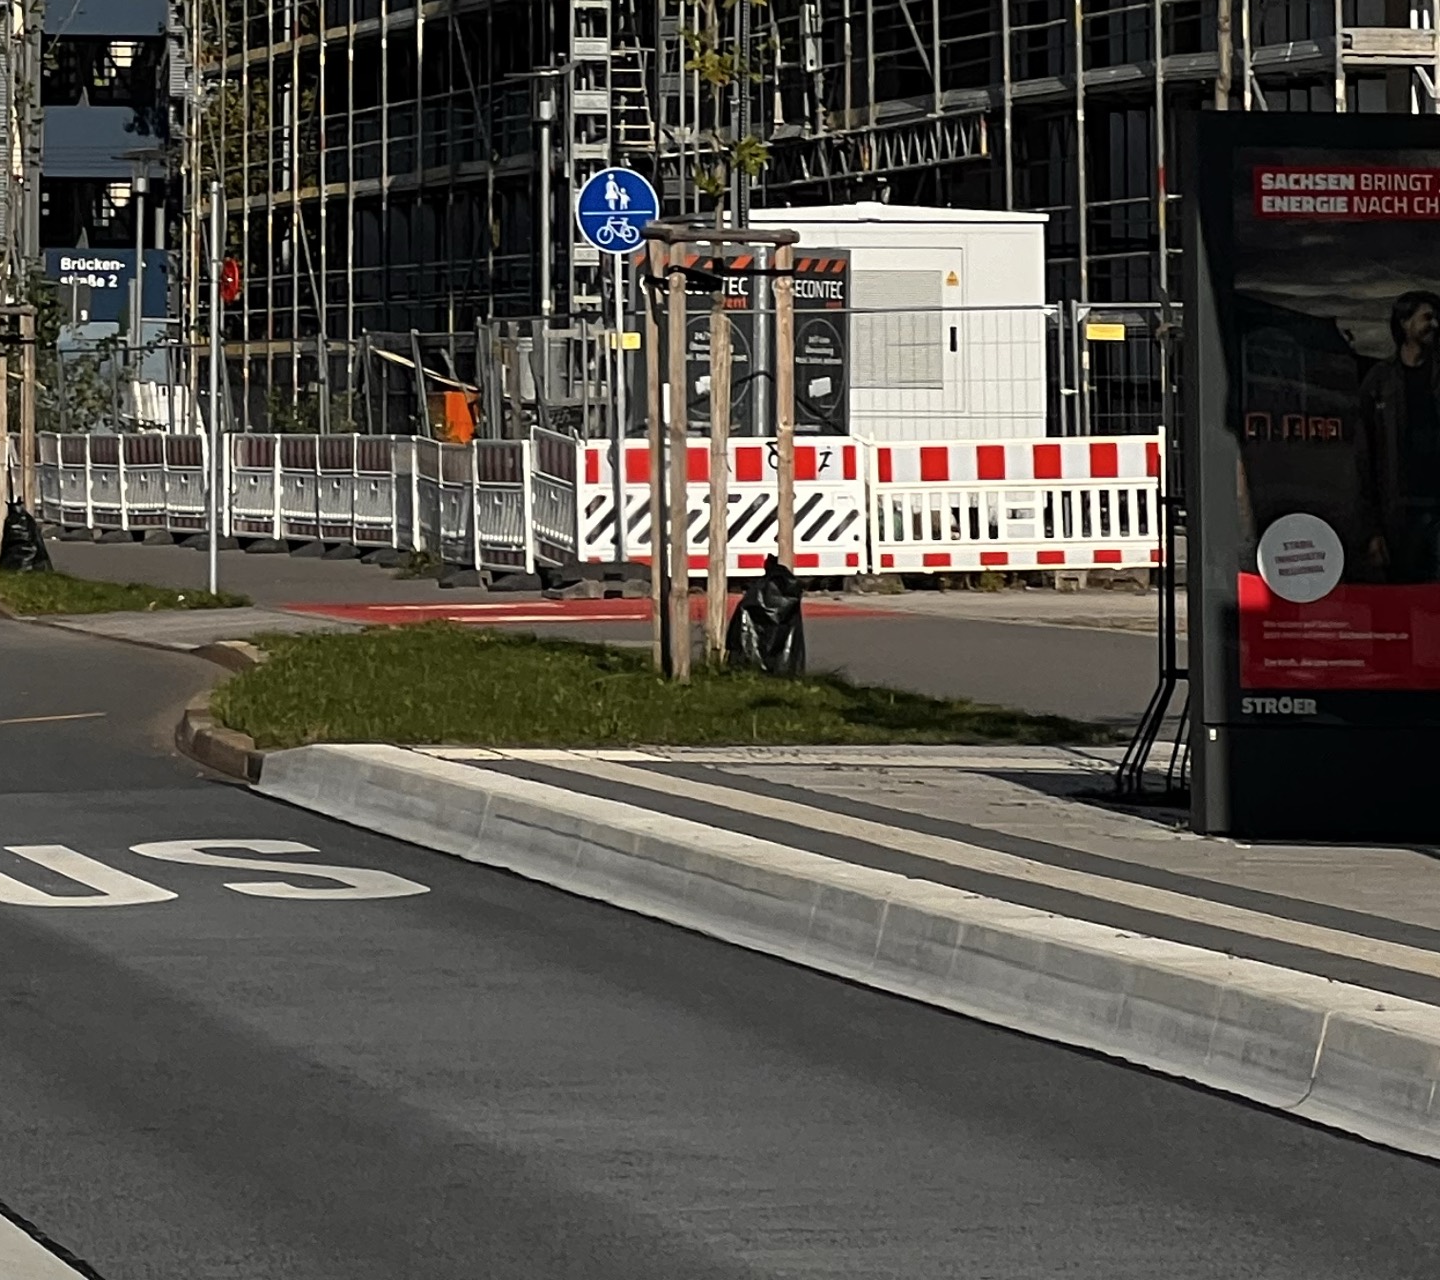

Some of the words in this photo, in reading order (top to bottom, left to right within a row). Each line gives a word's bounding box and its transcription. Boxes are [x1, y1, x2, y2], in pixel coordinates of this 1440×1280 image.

[1261, 173, 1355, 190] SACHSEN
[1360, 173, 1434, 191] BRINGT
[1261, 195, 1349, 213] ENERGIE
[1353, 196, 1408, 213] NACH
[60, 257, 126, 271] Brücken-
[108, 274, 118, 288] 2
[1241, 696, 1318, 715] STRÖER
